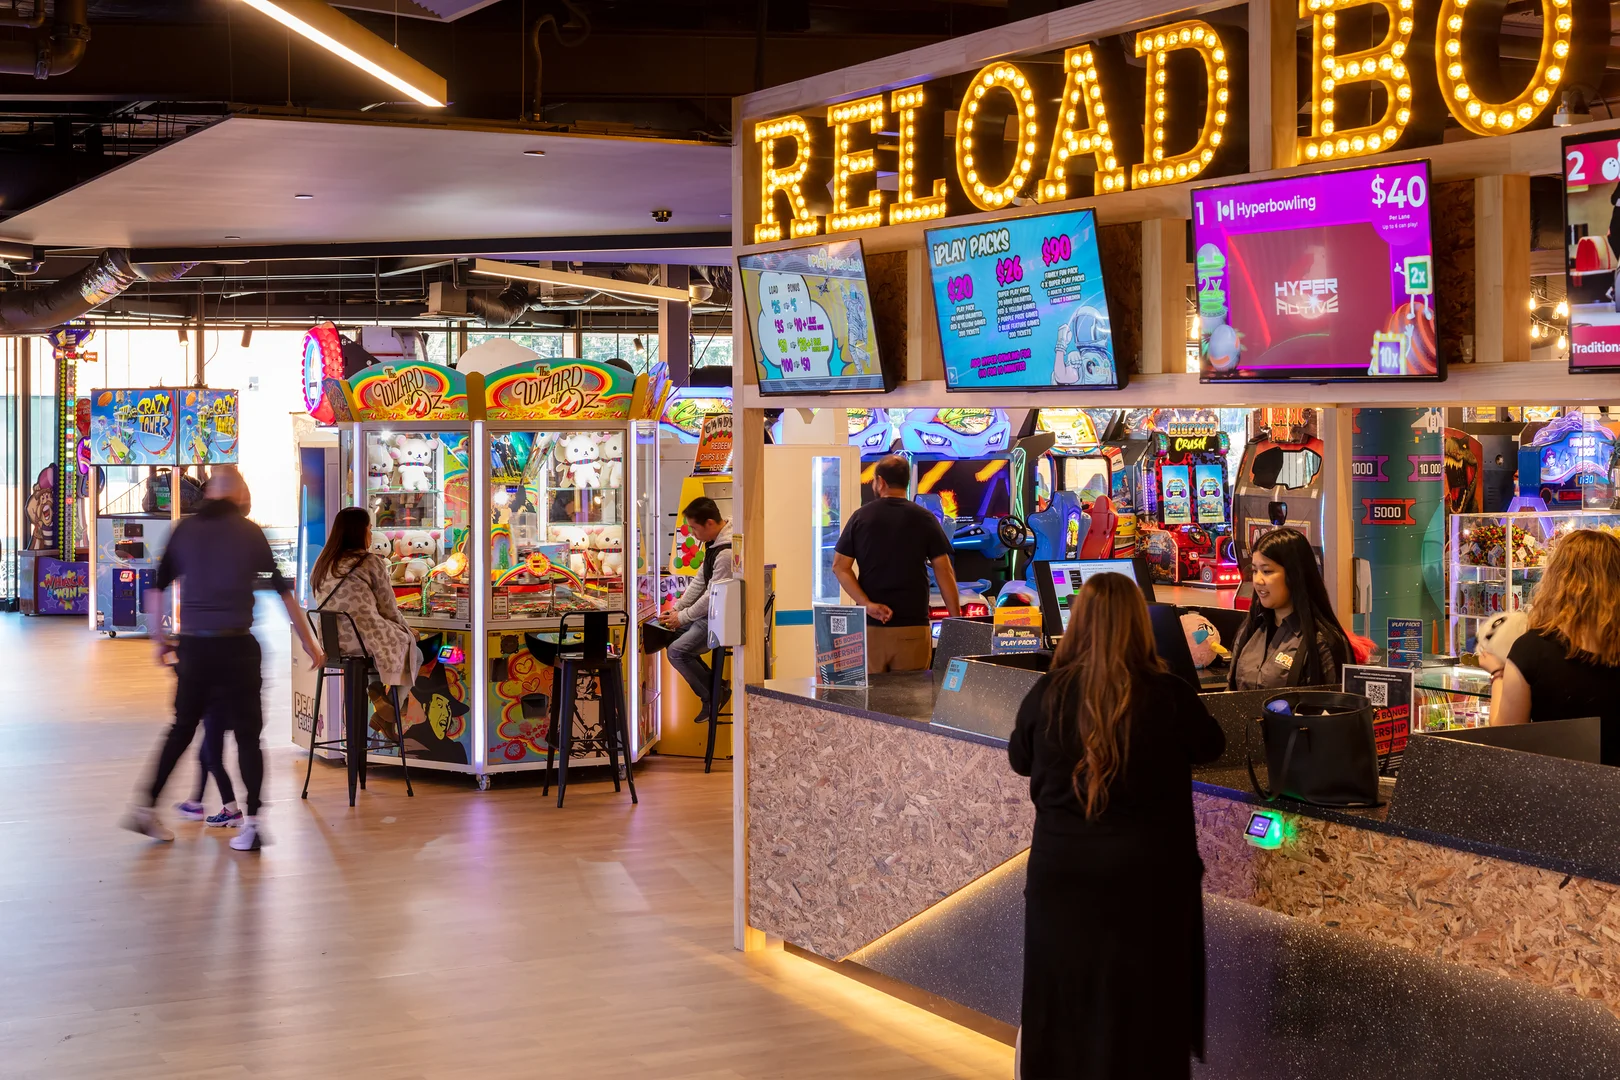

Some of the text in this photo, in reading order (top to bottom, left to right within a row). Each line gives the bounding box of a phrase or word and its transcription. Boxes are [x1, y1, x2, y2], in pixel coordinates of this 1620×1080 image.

[754, 19, 1229, 244] RELOAD
[1566, 150, 1585, 182] 2
[1370, 173, 1427, 209] $40
[1196, 194, 1317, 226] 1 Hyperbowling
[933, 228, 1010, 266] iPLAY PACKS
[1041, 233, 1072, 267] $90
[996, 255, 1024, 287] $26
[1411, 267, 1426, 284] 2x
[768, 283, 800, 295] LOAD BONUS
[947, 274, 974, 304] $20
[1275, 278, 1338, 296] HYPER
[1380, 346, 1399, 369] 10x
[384, 368, 397, 378] The
[536, 365, 551, 376] The
[373, 367, 424, 407] WIZARD
[514, 365, 583, 406] WIZARD
[137, 393, 170, 415] CRAZY
[213, 394, 236, 415] CRAZY
[550, 392, 560, 404] of
[1169, 423, 1216, 435] BIGFOOT
[711, 442, 732, 450] REDEEM
[1175, 436, 1208, 452] CRUSH
[1352, 462, 1373, 475] 1000
[1420, 464, 1429, 474] 10
[1374, 506, 1401, 518] 5000
[43, 575, 85, 590] WHACK
[844, 634, 862, 644] BONUS
[817, 646, 862, 663] MEMBERSHIP
[1381, 707, 1408, 718] BONUS
